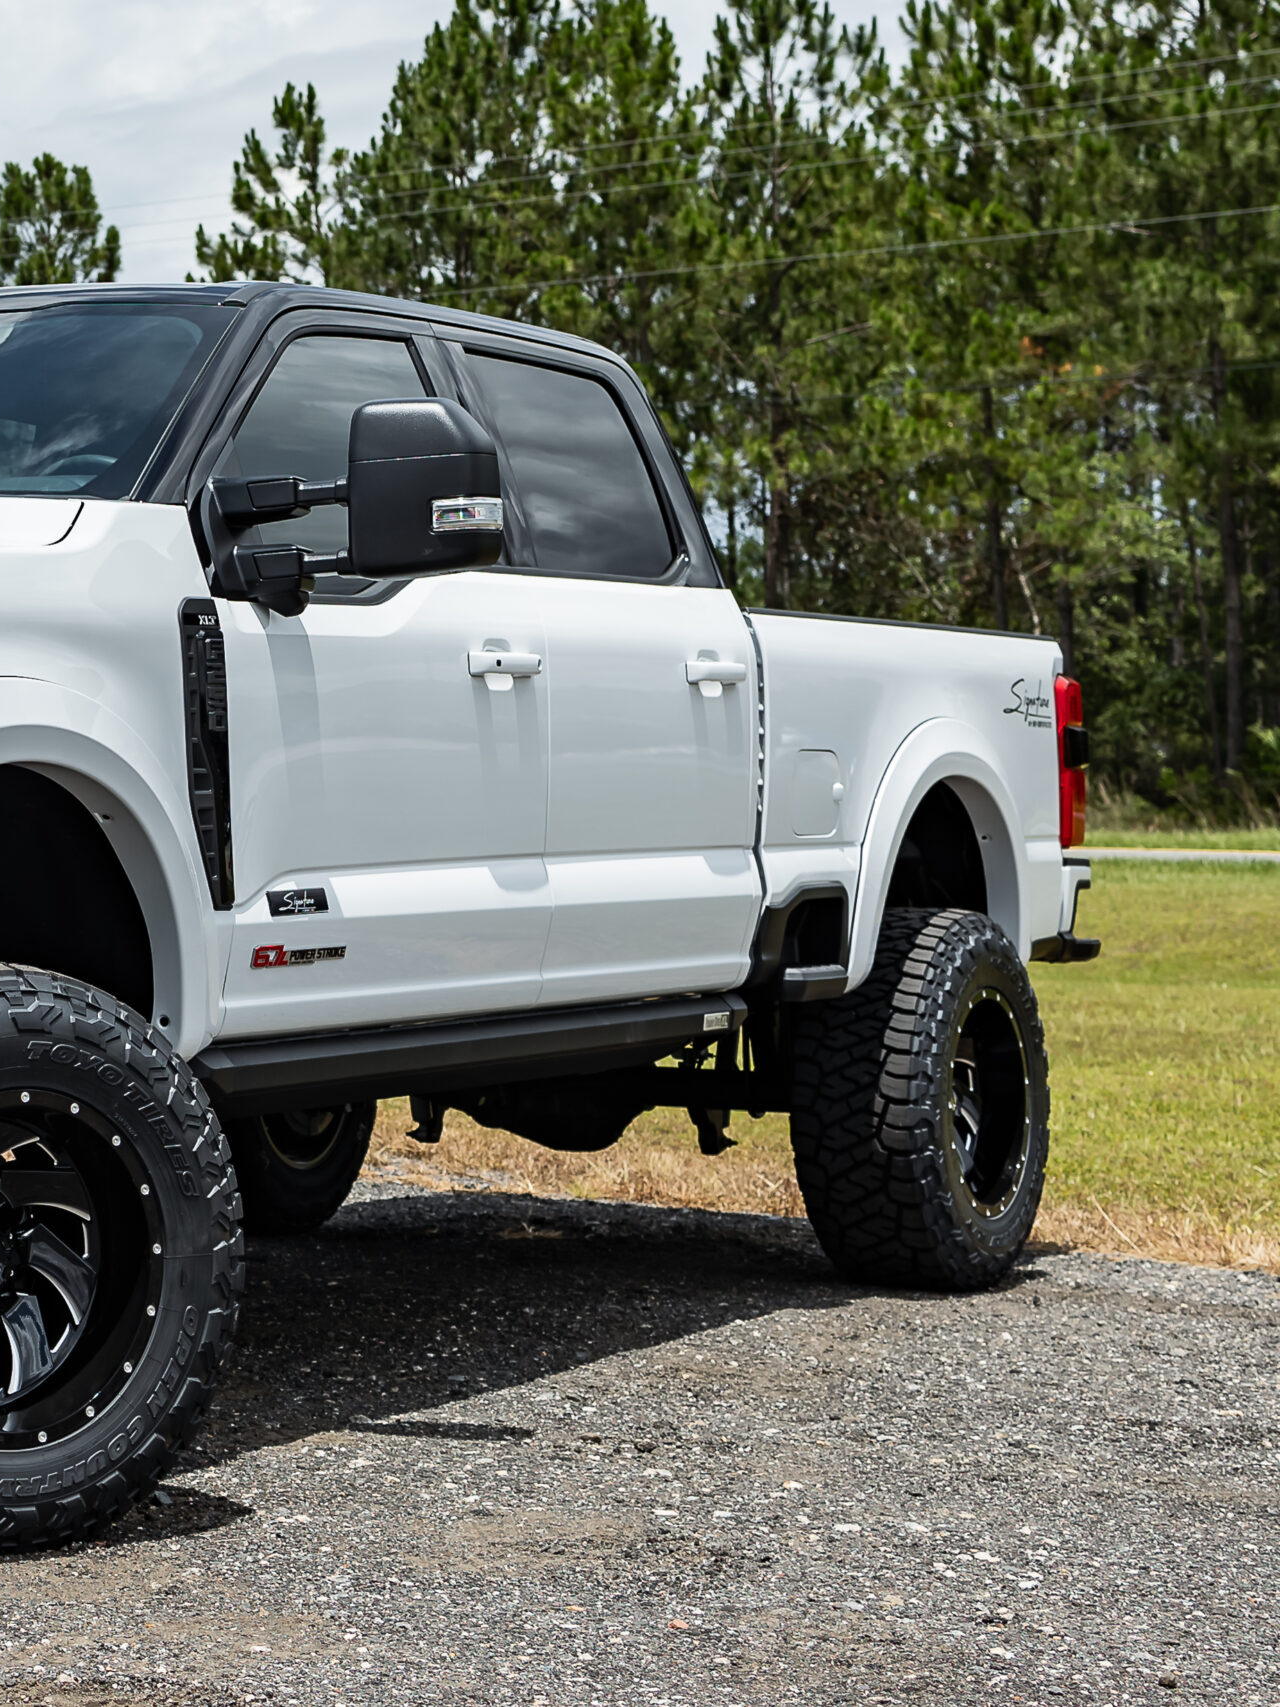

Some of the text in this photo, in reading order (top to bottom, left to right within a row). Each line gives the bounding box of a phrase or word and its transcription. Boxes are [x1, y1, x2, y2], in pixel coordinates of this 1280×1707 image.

[289, 949, 316, 961] POWER
[316, 946, 346, 959] STROKE
[27, 1040, 124, 1086] TOYO
[123, 1081, 201, 1198] TIRES
[146, 1304, 200, 1419] OPEN
